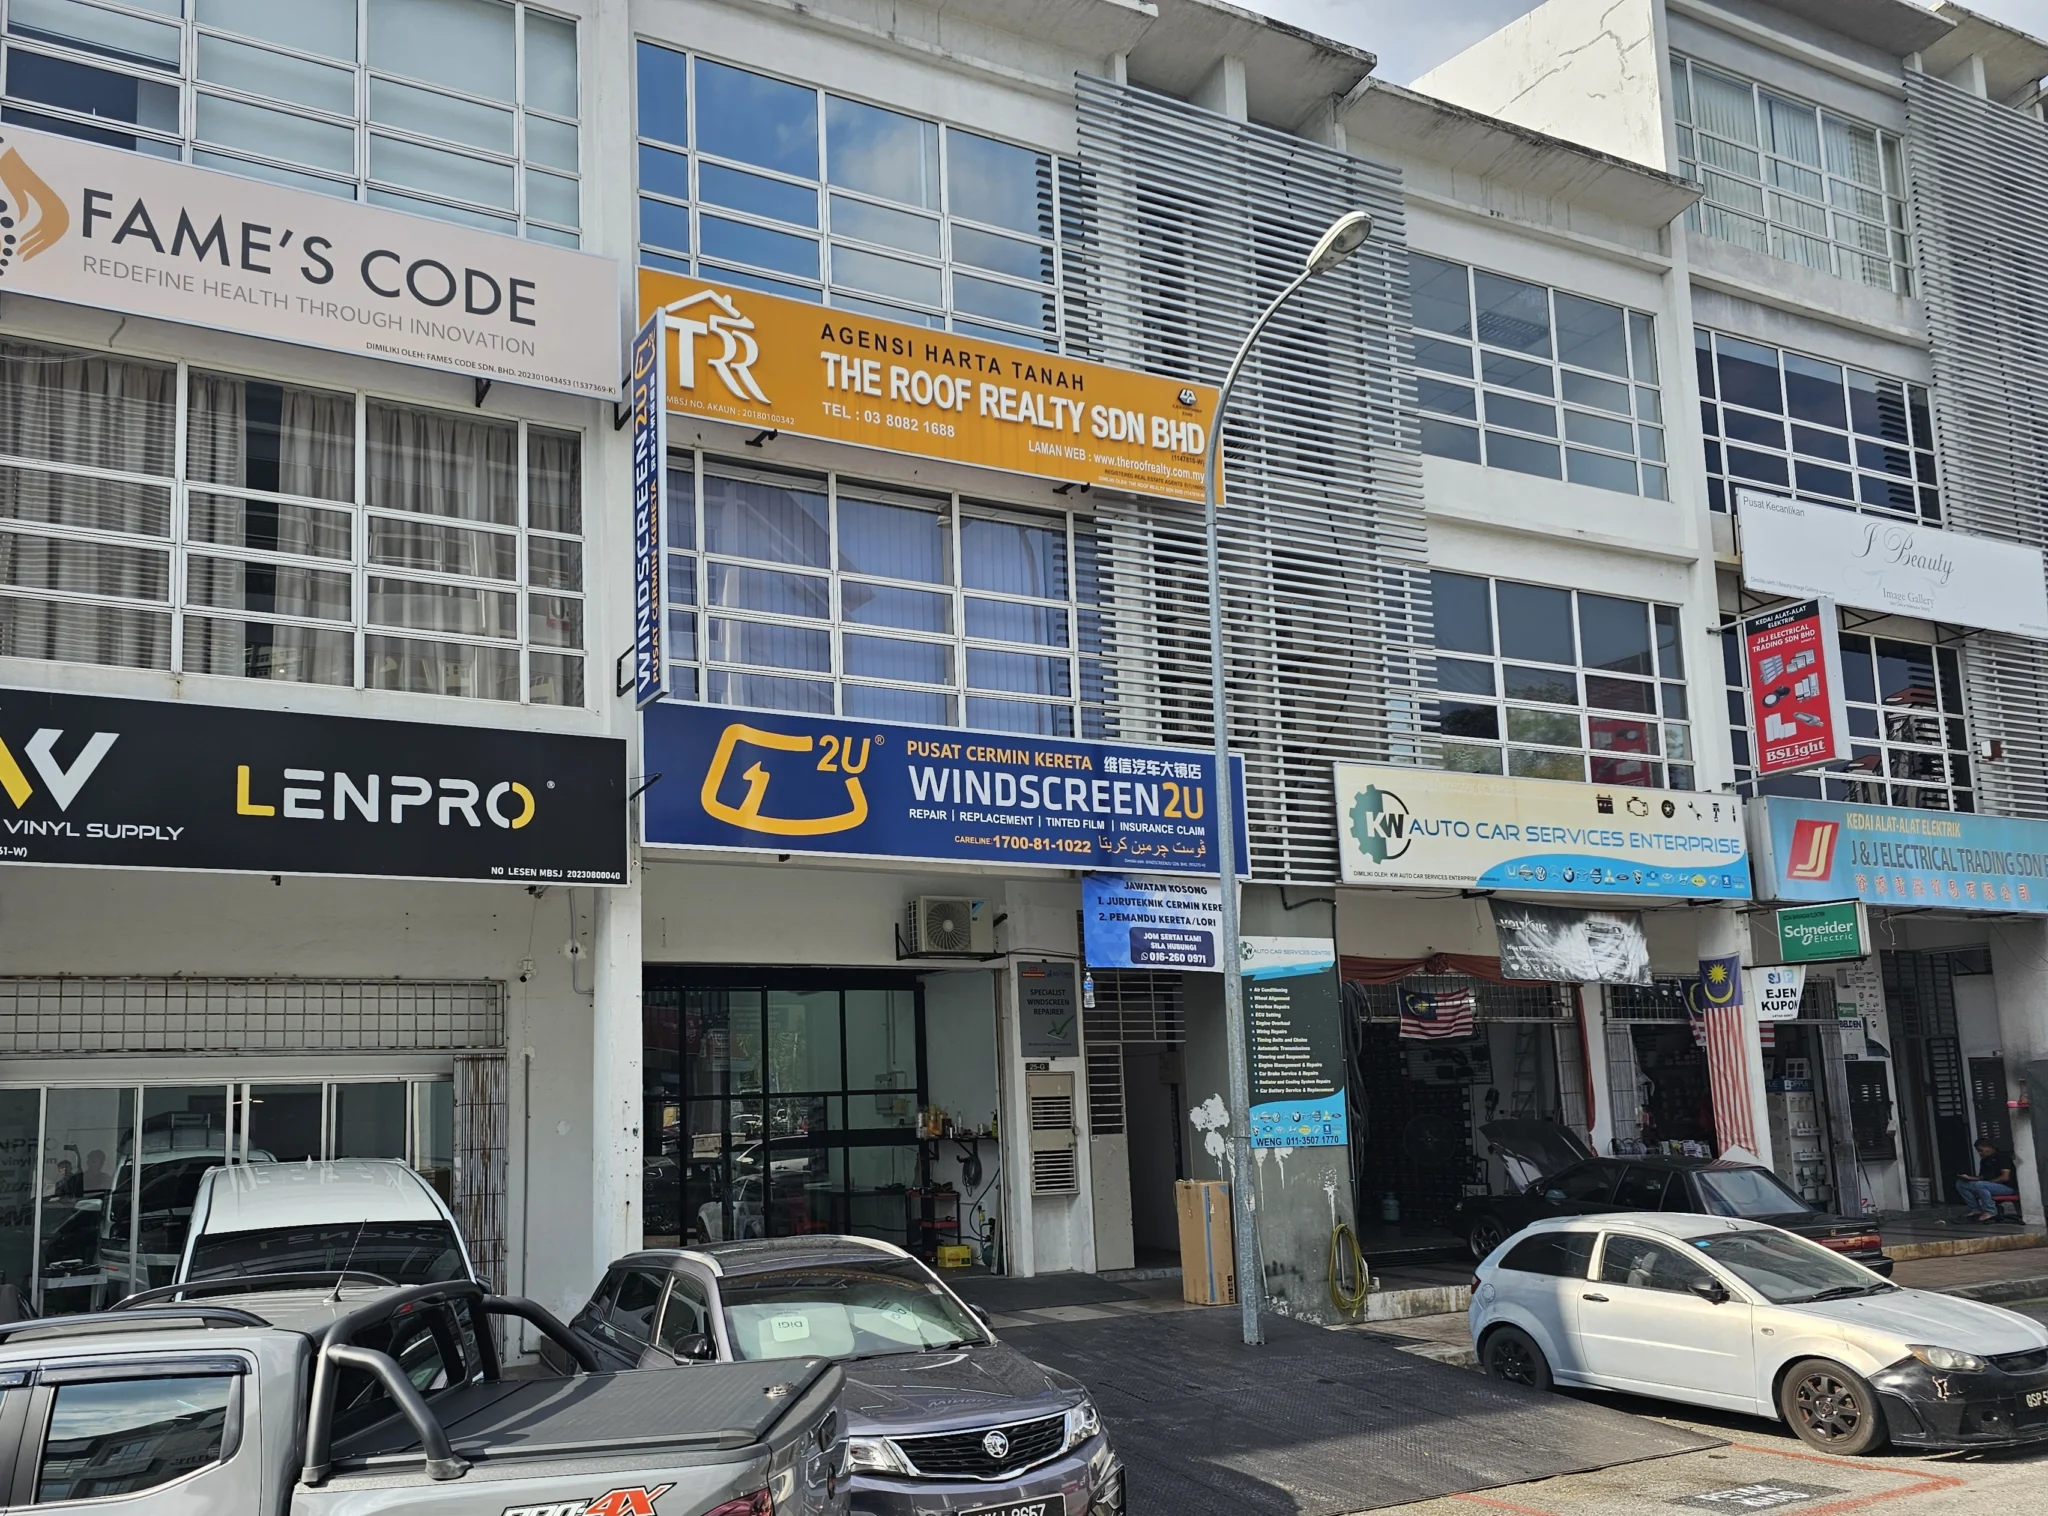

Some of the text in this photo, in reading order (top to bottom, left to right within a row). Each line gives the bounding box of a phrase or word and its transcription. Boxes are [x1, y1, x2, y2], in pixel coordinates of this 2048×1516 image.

[83, 188, 535, 326] FAME'S CODE
[83, 255, 534, 357] REDEFINE HEALTH THROUGH INNOVATION
[821, 323, 1084, 391] AGENSI HARTA TANAH
[366, 342, 616, 395] DIMILIKI OLEH: FAMES CODE SDN. BHD. 202301043453 (1537369-K)
[666, 396, 795, 425] MBSJ AKAUN 20180100342
[820, 351, 1205, 455] THE ROOF REALTY SDN BHD
[822, 401, 955, 438] TEL 03 8082 1688
[1028, 440, 1205, 484] LAMAN WEB www.theroofrealty.com.my
[1743, 496, 1805, 517] Pusat Kecantikan
[634, 395, 652, 694] WINDSCREEN2U
[1884, 527, 1954, 584] Beauty
[650, 480, 660, 683] PUSAT CERMIN KERETA
[1883, 588, 1906, 601] Image
[1907, 592, 1934, 608] Gallery
[1755, 605, 1806, 626] KEDAI ALAT-ALAT
[1767, 616, 1795, 629] ELEKTRIK
[1752, 640, 1783, 653] TRADING
[1784, 635, 1799, 644] SDN
[1801, 630, 1815, 638] BHD
[1757, 635, 1769, 645] J&J
[1770, 623, 1809, 640] ELECTRICAL
[907, 740, 1093, 770] PUSAT CERMIN KERETA
[1766, 740, 1826, 762] BSLight
[1104, 756, 1201, 780] 维信汽车大镜店
[237, 765, 535, 830] LENPRO
[908, 765, 1204, 820] WINDSCREEN2U
[3, 819, 184, 841] VINYL SUPPLY
[909, 808, 1205, 836] REPAIR REPLACEMENT TINTED FILM INSURANCE CLAIM
[1365, 811, 1740, 854] KW AUTO CAR SERVICES ENTERPRISE
[1847, 812, 1961, 838] KEDAI ALAT-ALAT ELEKTRIK
[993, 835, 1091, 853] 1700-81-1022
[1852, 840, 1857, 866] J
[1873, 842, 1878, 867] J
[1883, 843, 1957, 872] ELECTRICAL
[1957, 849, 2014, 876] TRADING
[2018, 853, 2041, 877] SDN
[491, 866, 620, 880] NO LESEN MBSJ 20230800040
[1124, 881, 1207, 895] JAWATAN KOSONG
[1106, 897, 1163, 908] JURUTEKNIK
[1166, 900, 1200, 911] CERMIN
[1110, 912, 1216, 927] PEMANDU KERETA/LORI
[1784, 921, 1853, 938] Schneider
[1143, 932, 1160, 940] JOM
[1161, 933, 1183, 941] SERTAI
[1151, 942, 1197, 951] SILA HUBUNGI
[1814, 933, 1853, 943] Electric
[1150, 952, 1206, 963] 016-260 0971
[1027, 998, 1069, 1006] WINDSCREEN
[1766, 988, 1797, 998] EJEN
[1761, 1000, 1798, 1011] KUPON
[1840, 1020, 1862, 1028] BELDEN
[1029, 1063, 1046, 1071] 25-G
[1256, 1136, 1339, 1146] WENG 011-3507 1770
[2026, 1393, 2042, 1407] QSP
